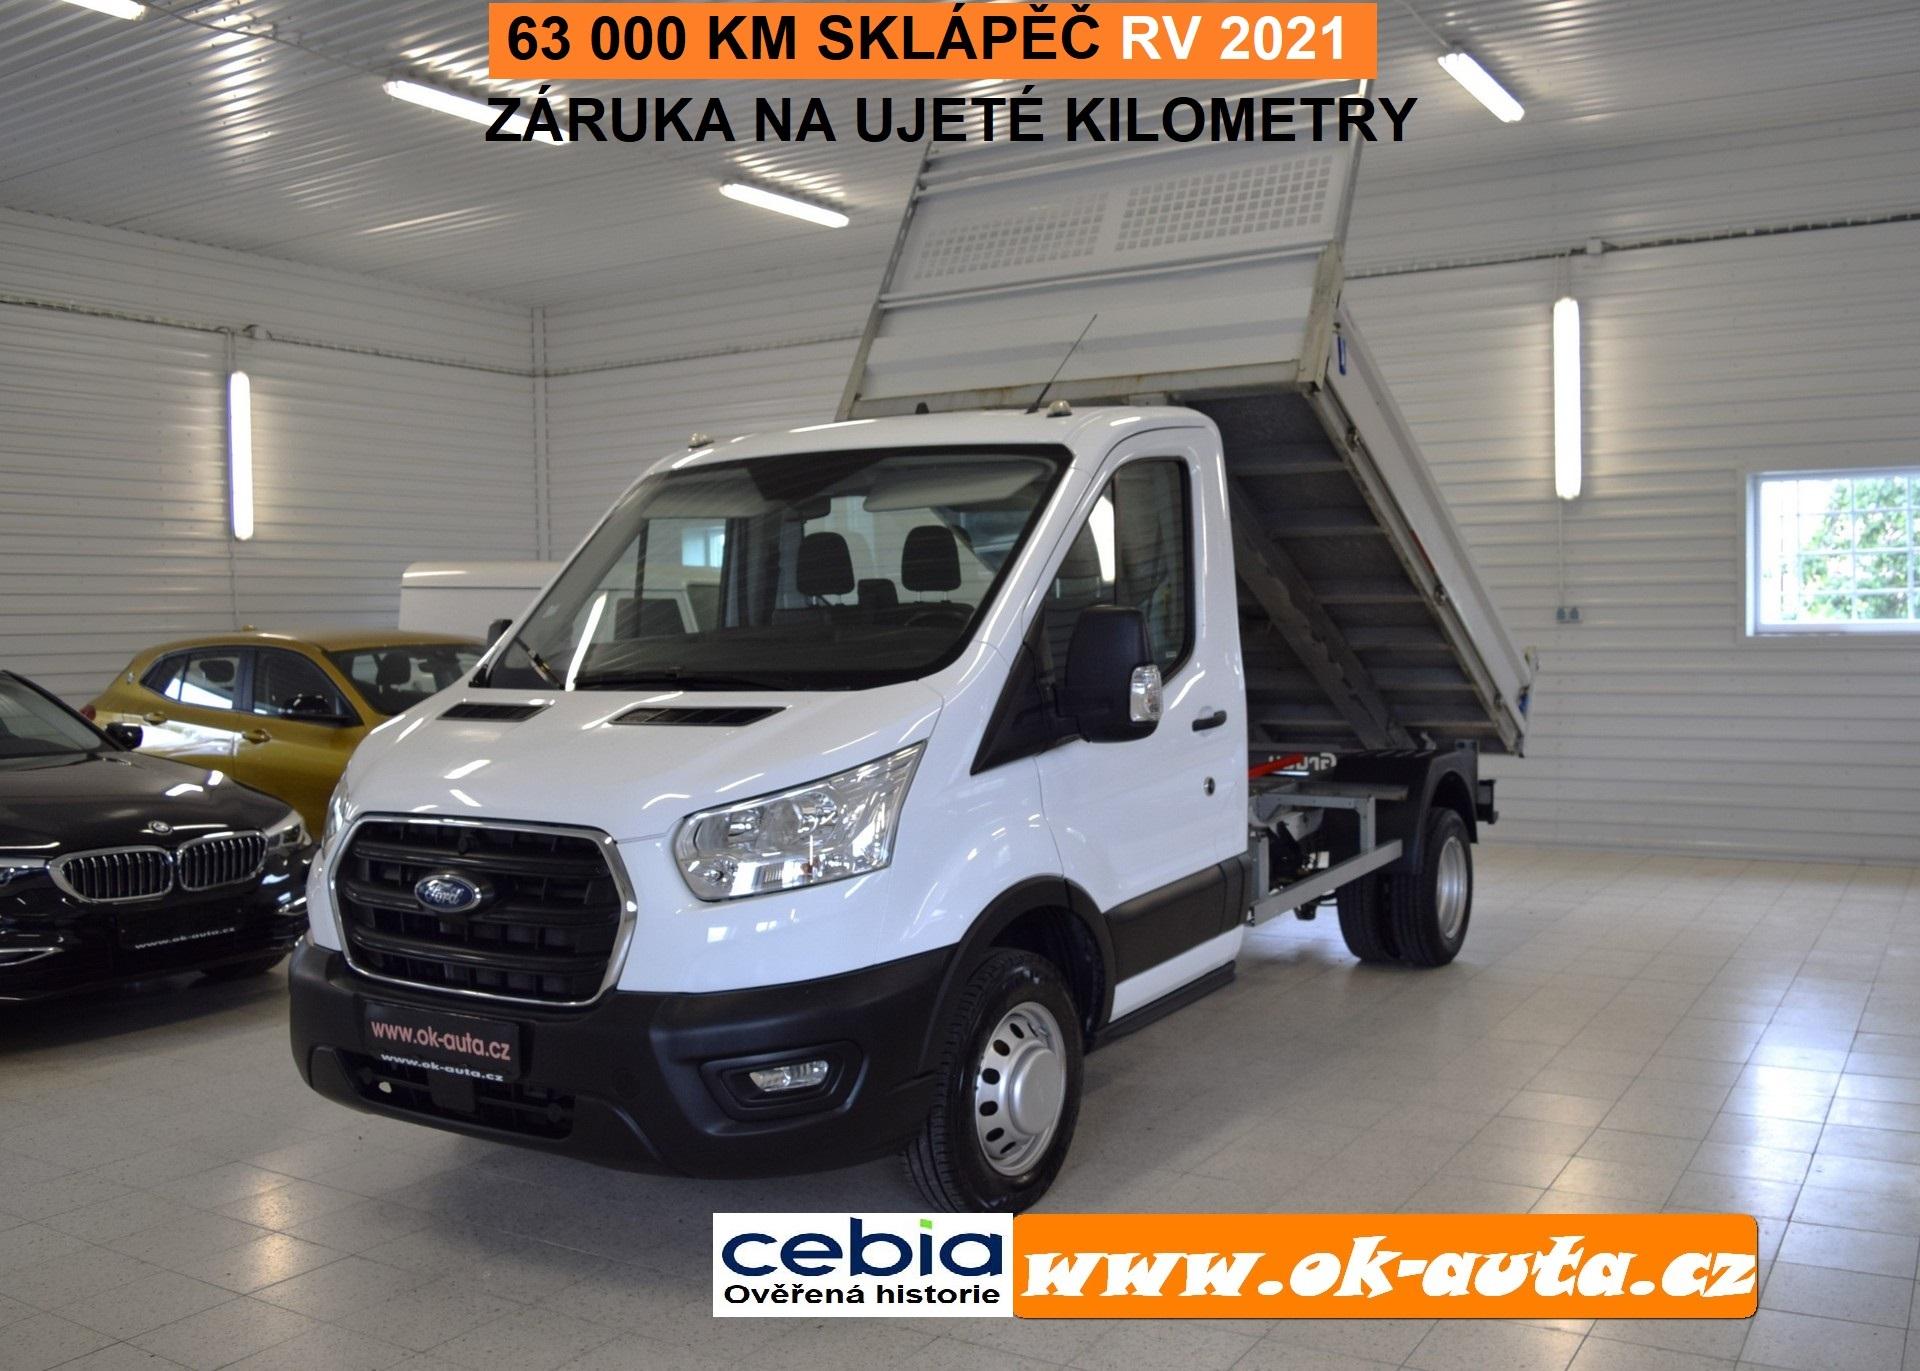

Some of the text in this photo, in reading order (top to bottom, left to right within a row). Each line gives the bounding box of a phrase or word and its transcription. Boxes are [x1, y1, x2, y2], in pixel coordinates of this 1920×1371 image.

[424, 880, 465, 904] Ford
[371, 1021, 511, 1061] www.ok-auta.cz
[380, 1053, 504, 1082] www.ok-auta.cz
